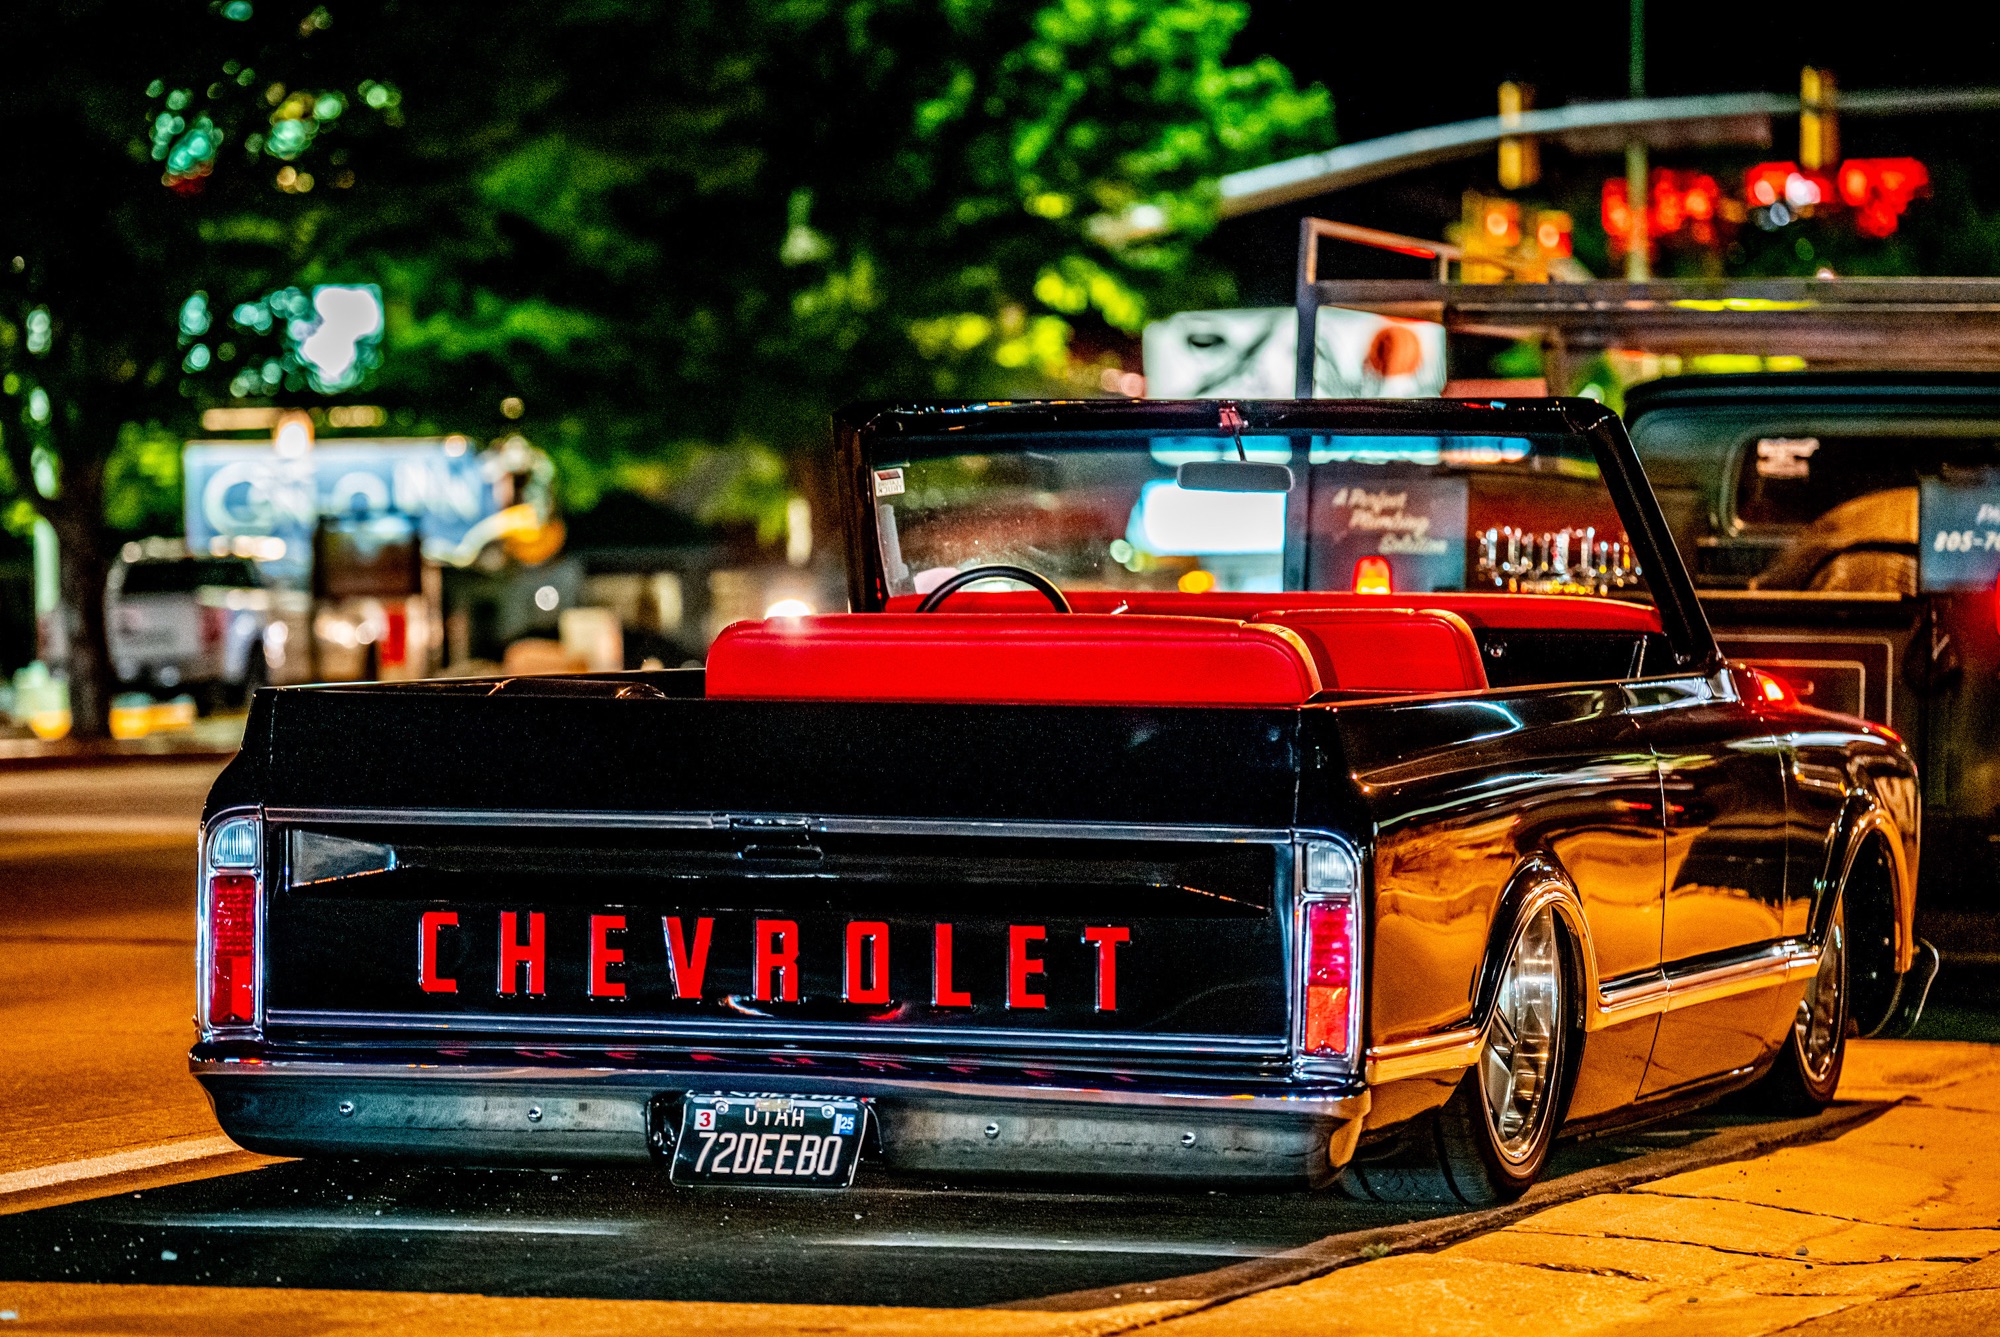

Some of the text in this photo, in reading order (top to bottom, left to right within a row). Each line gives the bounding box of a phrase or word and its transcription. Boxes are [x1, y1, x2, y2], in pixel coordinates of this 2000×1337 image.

[418, 911, 1131, 1011] CHEVROLET
[698, 1112, 711, 1127] 3
[745, 1107, 805, 1127] UTAH
[840, 1116, 854, 1130] 25
